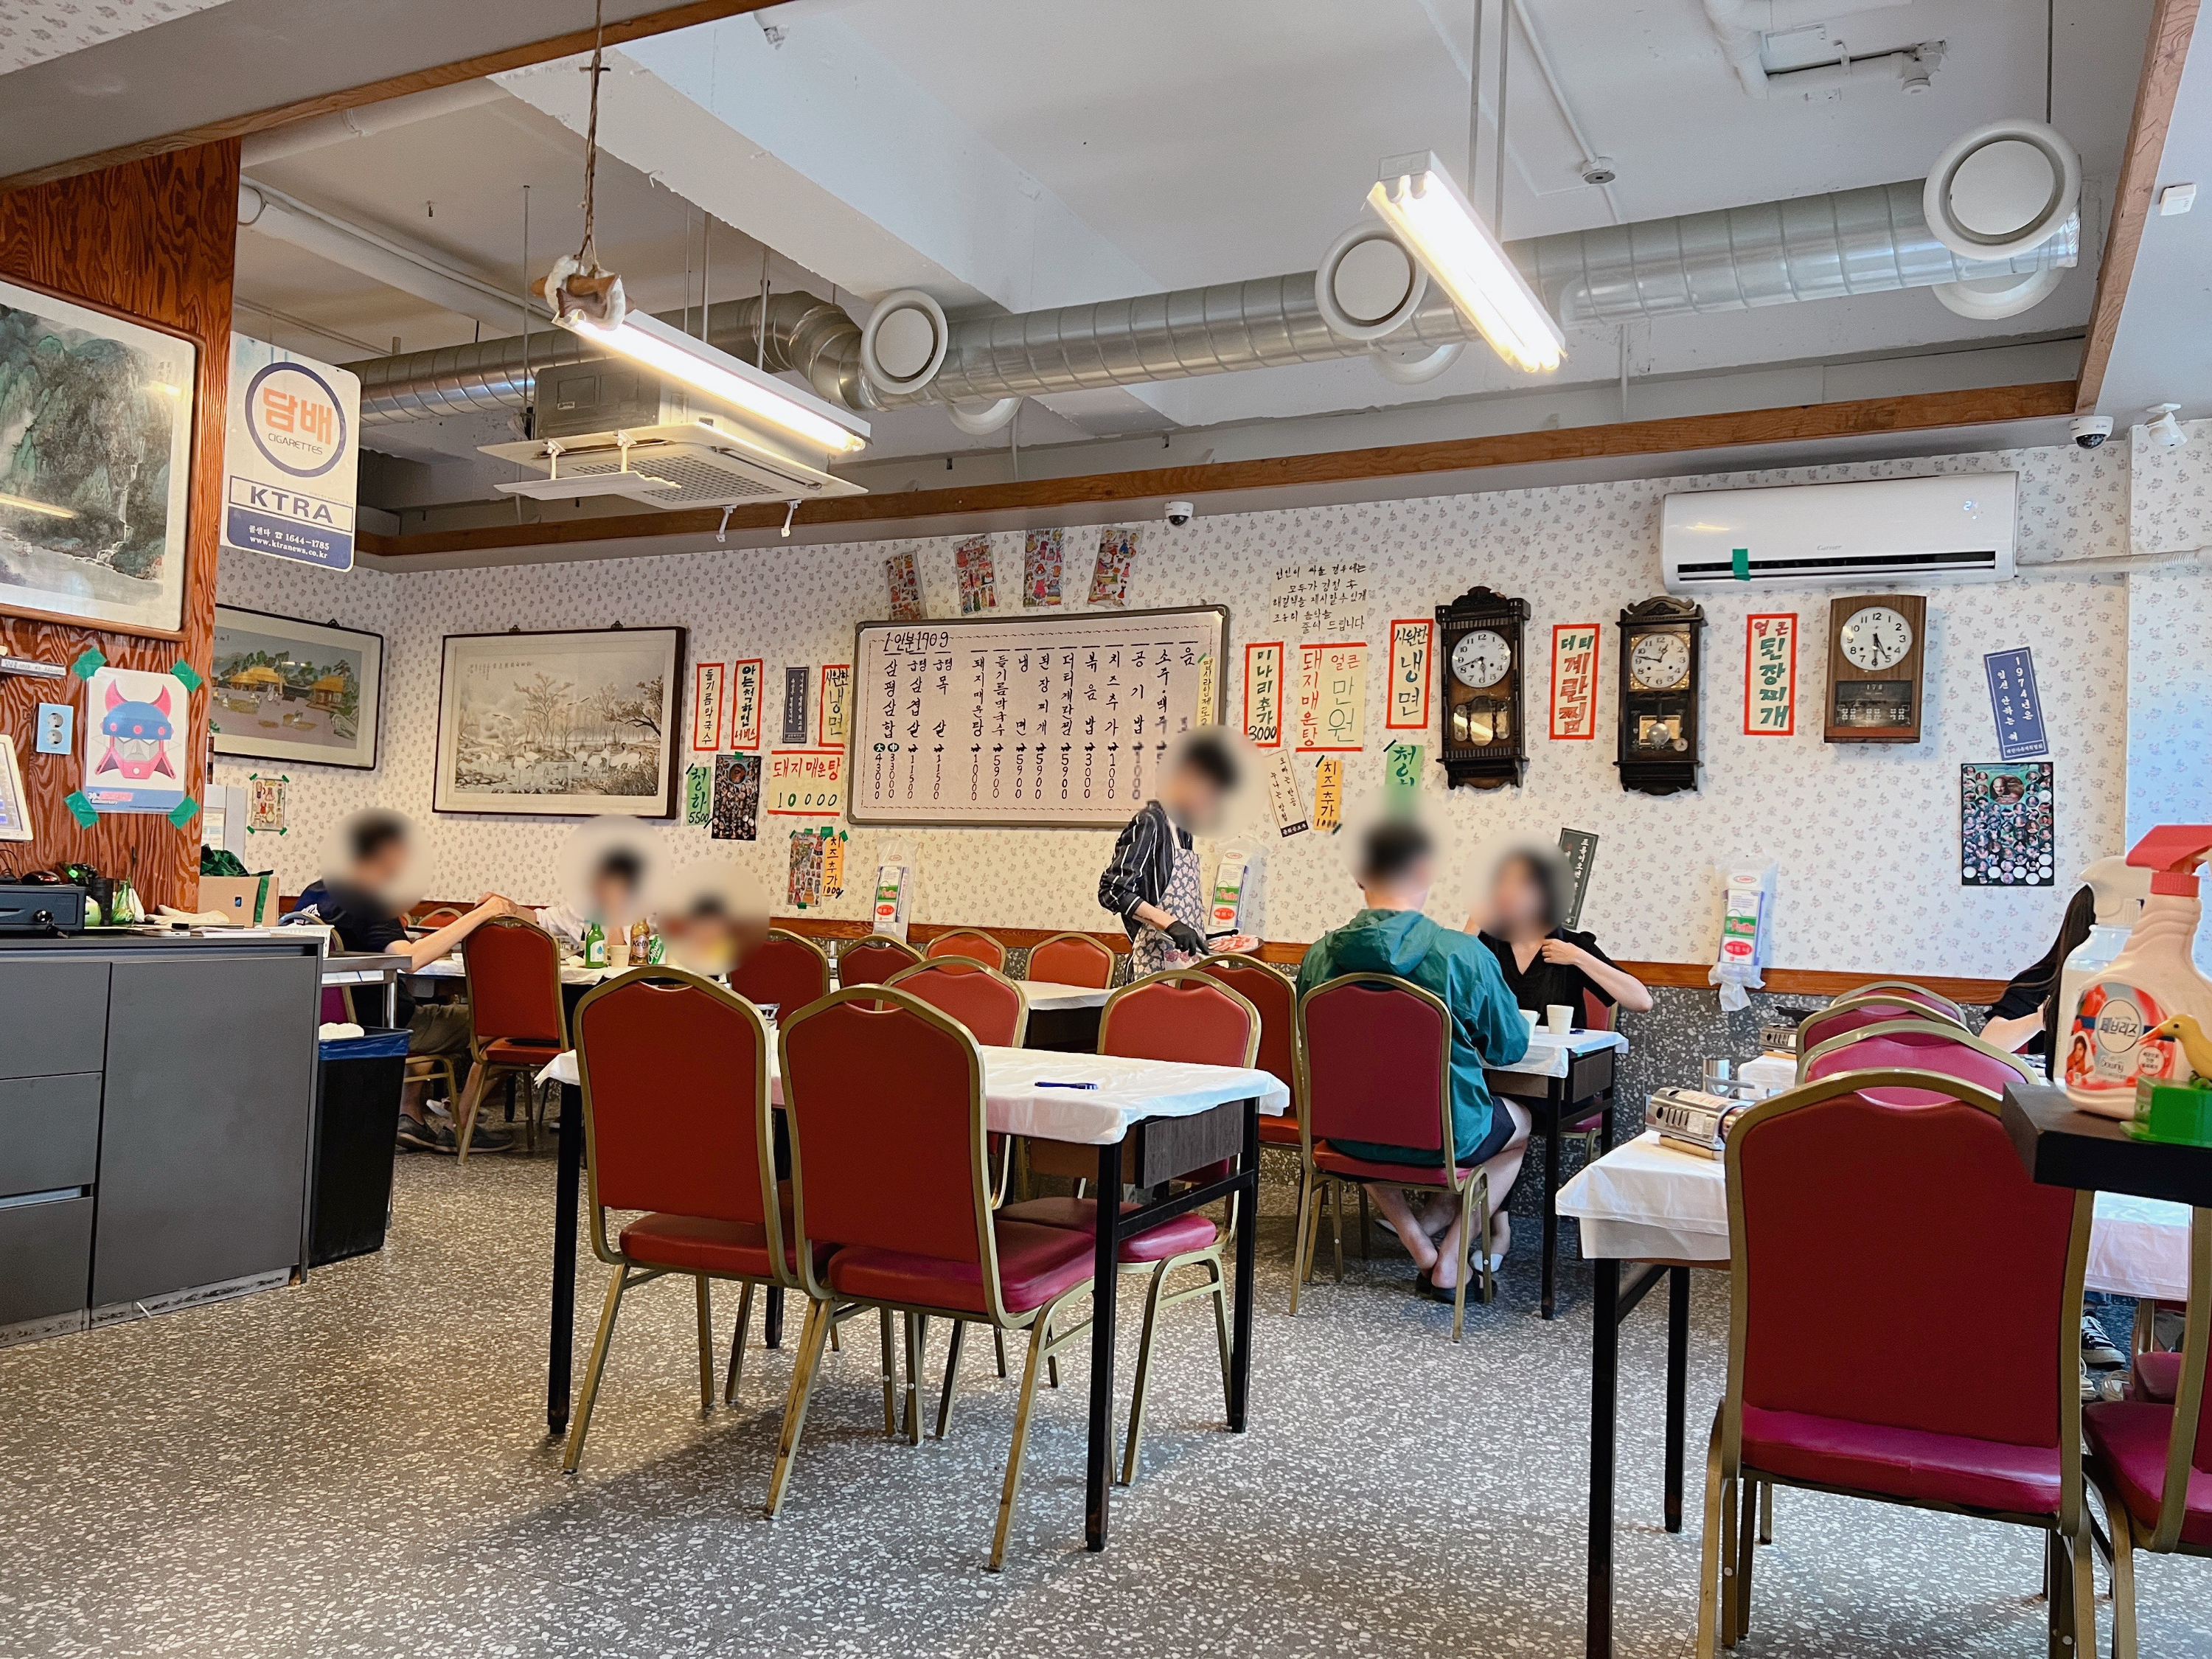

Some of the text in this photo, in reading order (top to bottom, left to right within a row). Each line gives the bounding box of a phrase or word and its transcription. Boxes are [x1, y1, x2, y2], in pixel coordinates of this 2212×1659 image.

[263, 387, 333, 445] 담배
[268, 433, 324, 455] CIGARETTES
[250, 485, 334, 524] KTRA
[250, 535, 328, 559] www.ktranews.co.kr
[285, 533, 330, 551] 1644-1785
[1288, 580, 1317, 593] 모두가
[1327, 615, 1365, 631] 드립니다
[1394, 625, 1429, 647] 시원한
[1561, 635, 1594, 650] 더티
[1896, 623, 1902, 631] 2
[1331, 653, 1360, 671] 얼큰
[1850, 647, 1857, 655] 8
[1885, 655, 1891, 663] 5
[825, 668, 849, 687] 시원한
[972, 656, 985, 737] 돼지매운탕
[992, 655, 1009, 737] 들기름막국수
[1037, 653, 1050, 736] 된장찌개
[1105, 650, 1120, 737] 치즈추가
[1130, 650, 1146, 734] 공기밥
[1256, 650, 1273, 725] 미나리추가
[1301, 649, 1323, 746] 돼지매운탕
[1399, 650, 1423, 716] 냉면
[1559, 653, 1591, 734] 계란찜
[1759, 638, 1789, 727] 된장찌개
[2016, 656, 2034, 720] 1974년은
[701, 669, 715, 745] 들기름막국수
[829, 686, 844, 735] 냉면
[1328, 676, 1354, 742] 만원
[734, 728, 757, 741] 서비스
[875, 743, 884, 752] 大
[889, 743, 898, 752] 中
[1248, 726, 1277, 741] 3000
[691, 767, 708, 812] 청하
[874, 753, 883, 800] 43000
[933, 754, 942, 800] 11500
[992, 755, 1001, 799] 5900
[1015, 754, 1023, 799] 5900
[1035, 753, 1043, 799] 5900
[1084, 753, 1092, 799] 3000
[1107, 753, 1116, 799] 1000
[1321, 762, 1336, 817] 치즈추가
[689, 810, 709, 824] 5500
[778, 793, 837, 808] 10000
[826, 835, 842, 886] 치즈추가
[823, 885, 841, 895] 1000
[632, 939, 648, 949] Kelly
[2099, 1018, 2138, 1037] 페브리즈
